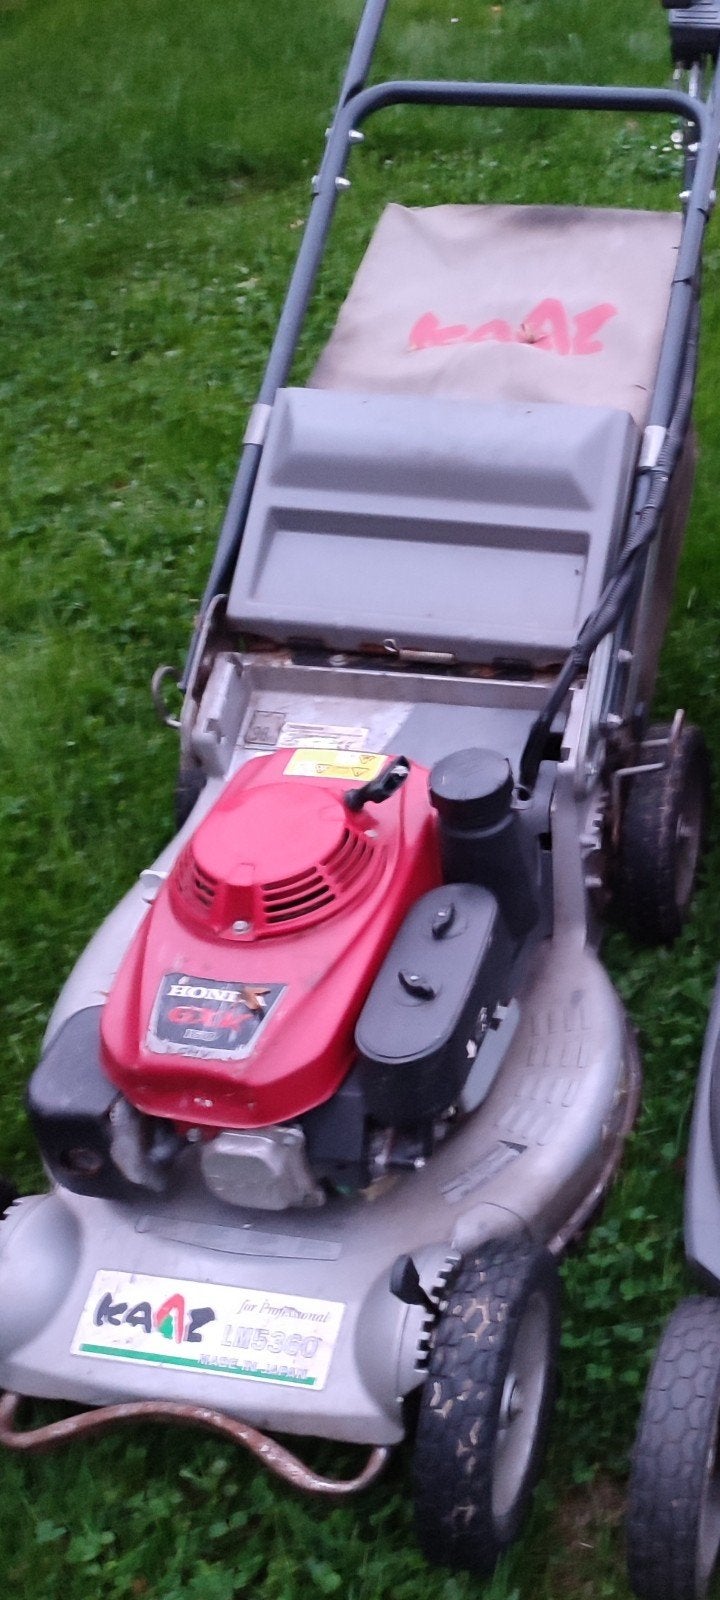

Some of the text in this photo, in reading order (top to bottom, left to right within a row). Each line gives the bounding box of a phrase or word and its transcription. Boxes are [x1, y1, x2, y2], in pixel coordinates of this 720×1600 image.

[93, 1292, 216, 1344] KAAZ
[237, 1299, 330, 1323] for Profional
[220, 1324, 321, 1359] LM5360
[200, 1353, 309, 1379] MADE IN JAPAN
